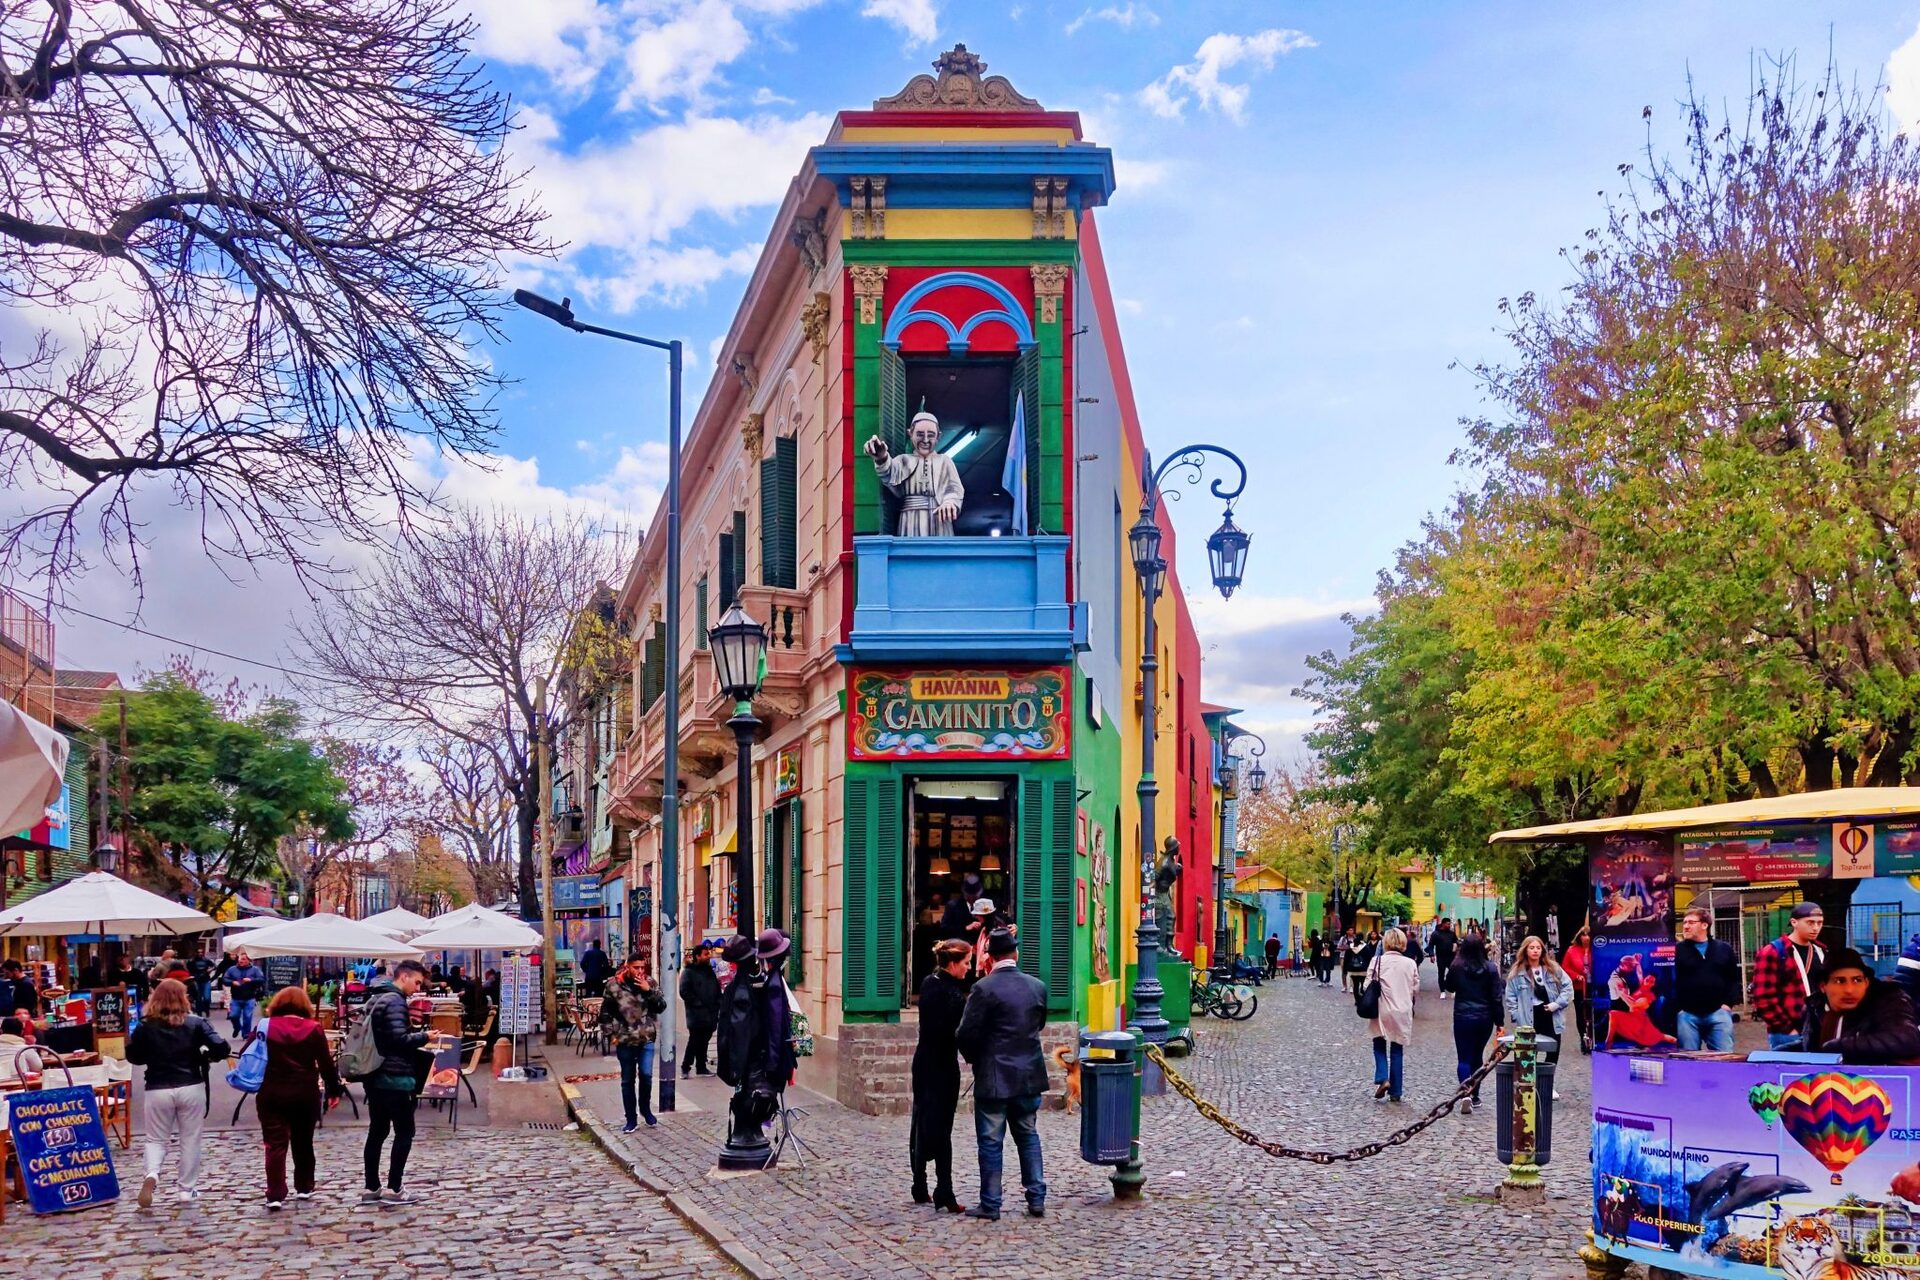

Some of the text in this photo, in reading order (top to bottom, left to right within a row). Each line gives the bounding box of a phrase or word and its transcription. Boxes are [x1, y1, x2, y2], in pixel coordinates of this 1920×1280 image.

[920, 679, 1002, 696] HAVANNA
[884, 698, 1037, 730] CAMINITO
[15, 1099, 87, 1119] CHOCOLATE
[19, 1112, 92, 1133] CON CHURROS
[46, 1129, 71, 1145] 130
[29, 1154, 64, 1172] CAFE
[1640, 1146, 1709, 1163] MUNDO MARINO
[63, 1184, 88, 1202] 130
[1633, 1213, 1706, 1234] POLO EXPERIENCE
[1862, 1253, 1893, 1264] ZOO
